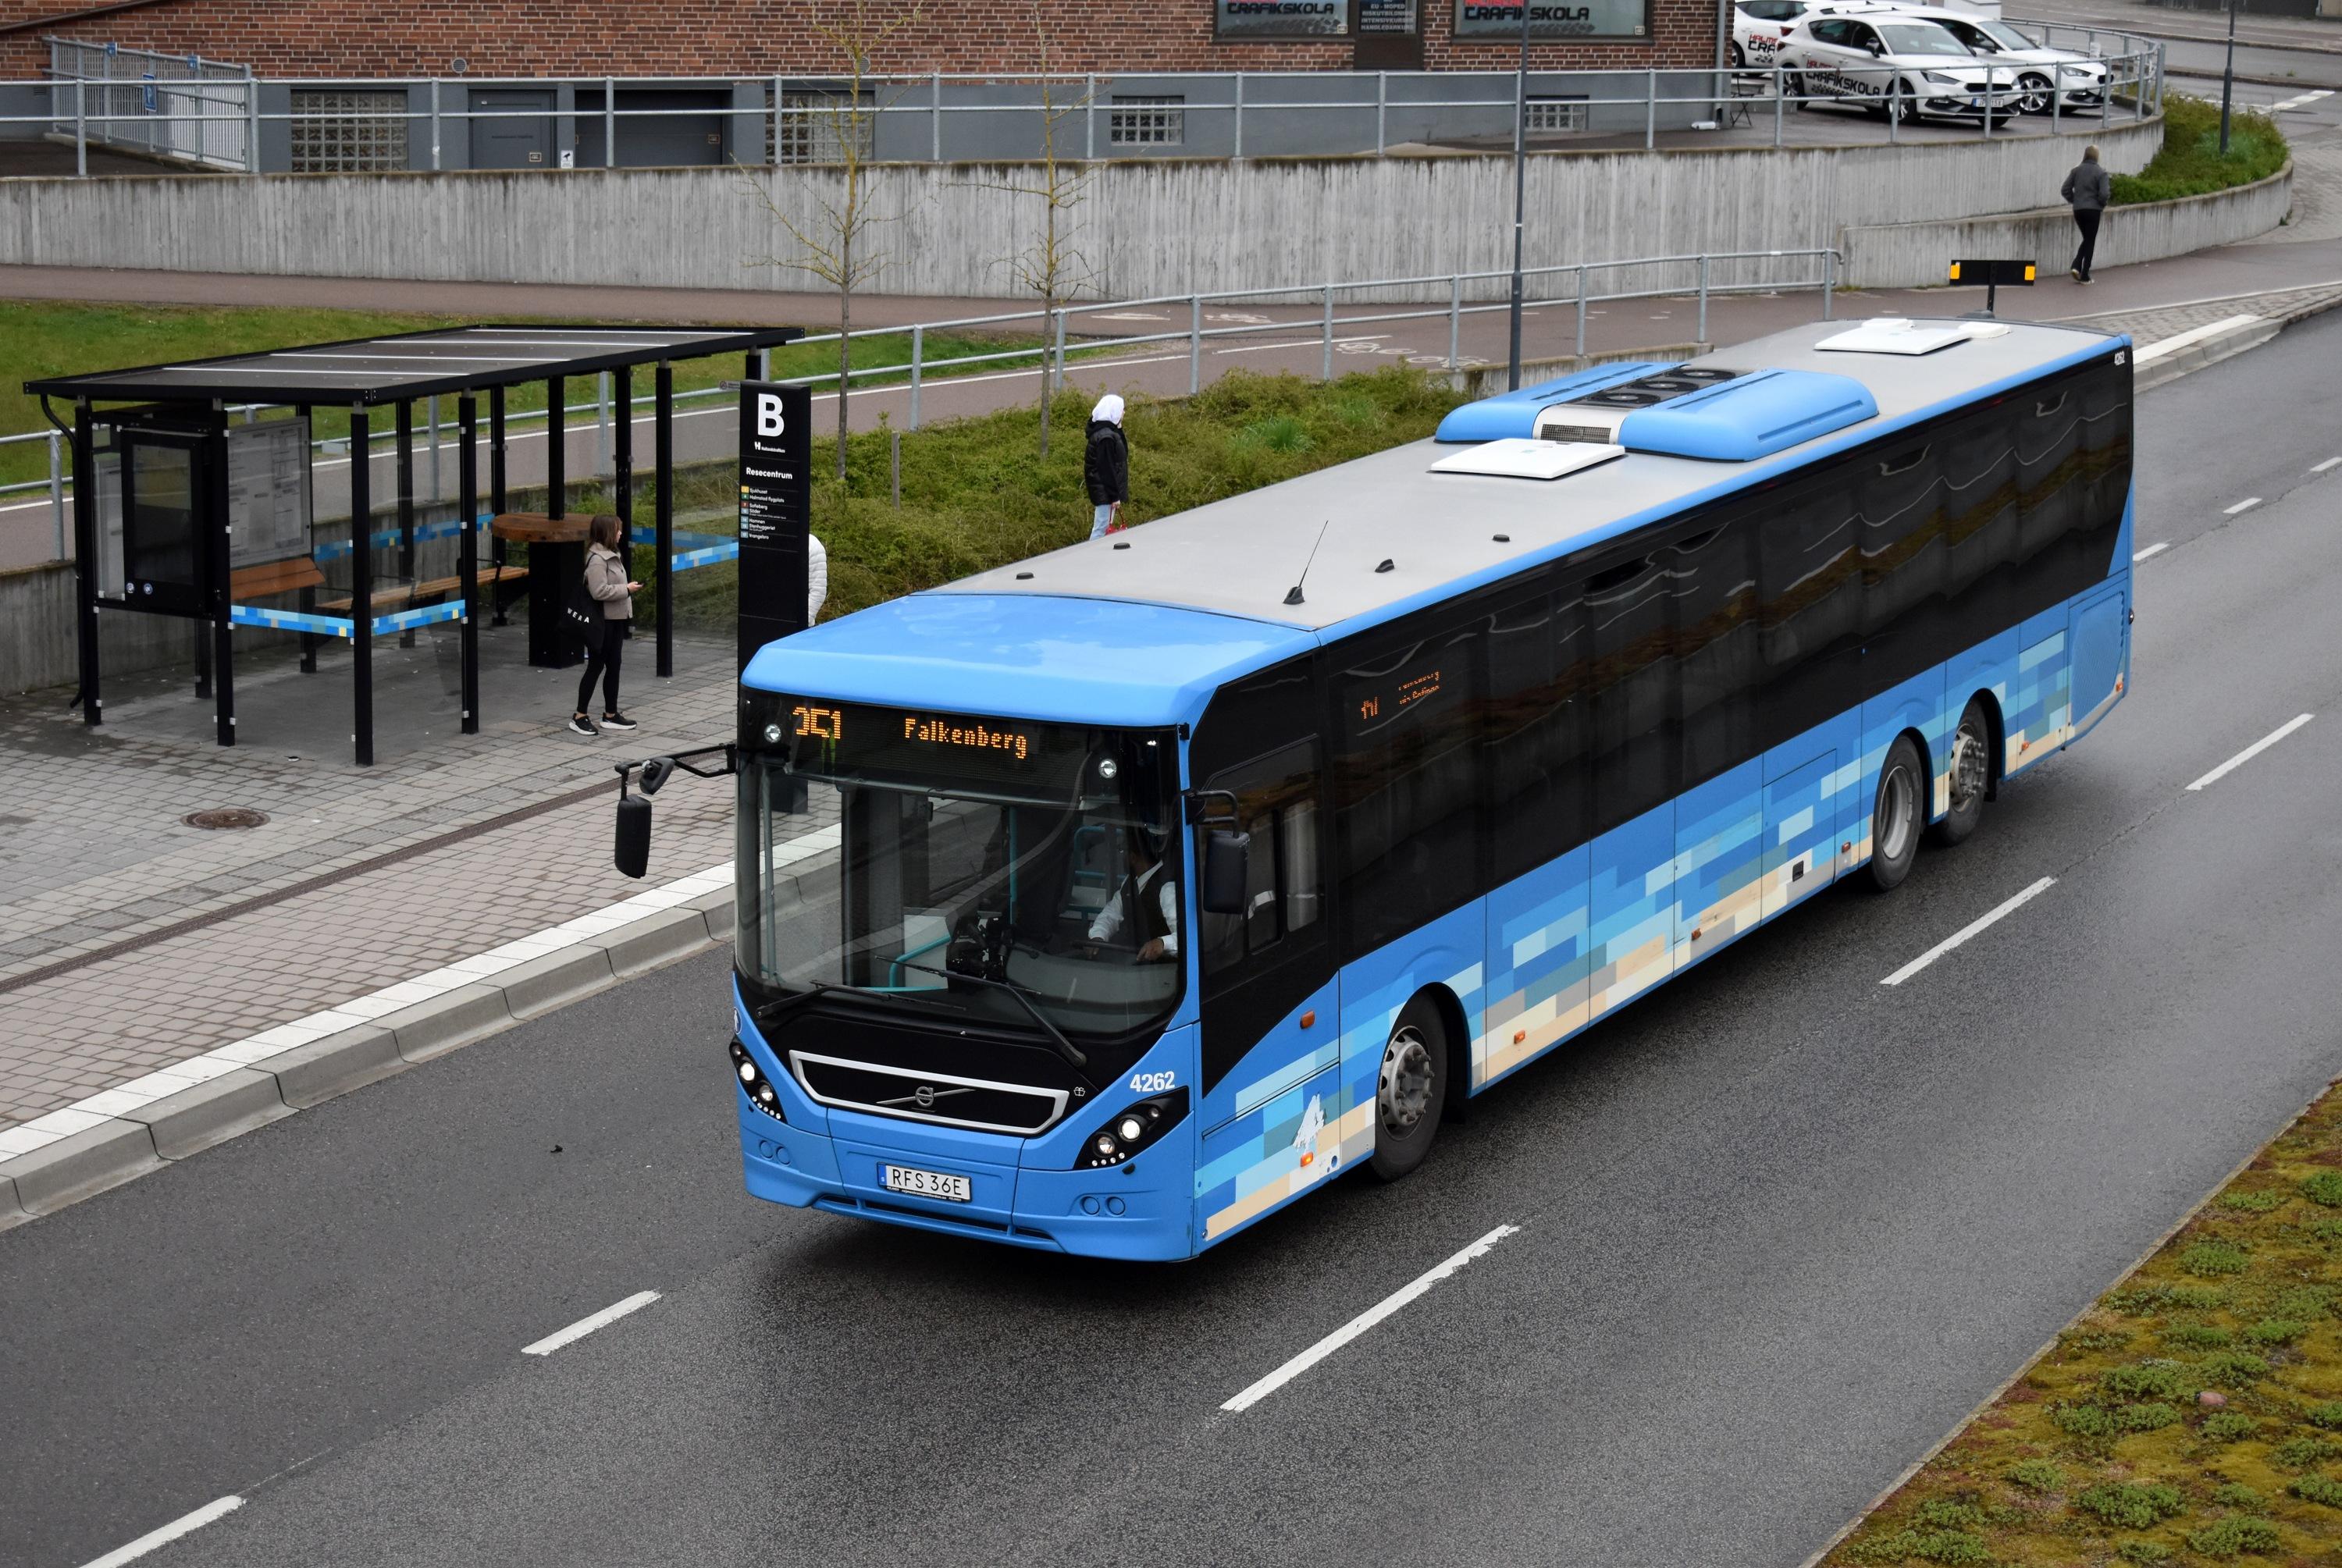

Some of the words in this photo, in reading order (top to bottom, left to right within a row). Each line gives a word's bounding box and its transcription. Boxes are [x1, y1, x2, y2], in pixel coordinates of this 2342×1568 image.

[757, 393, 785, 437] B
[746, 467, 792, 479] Resecentrum
[905, 718, 1027, 759] Falkenberg
[1130, 1071, 1175, 1092] 4262
[892, 1168, 924, 1189] RFS
[930, 1175, 962, 1196] 36E
